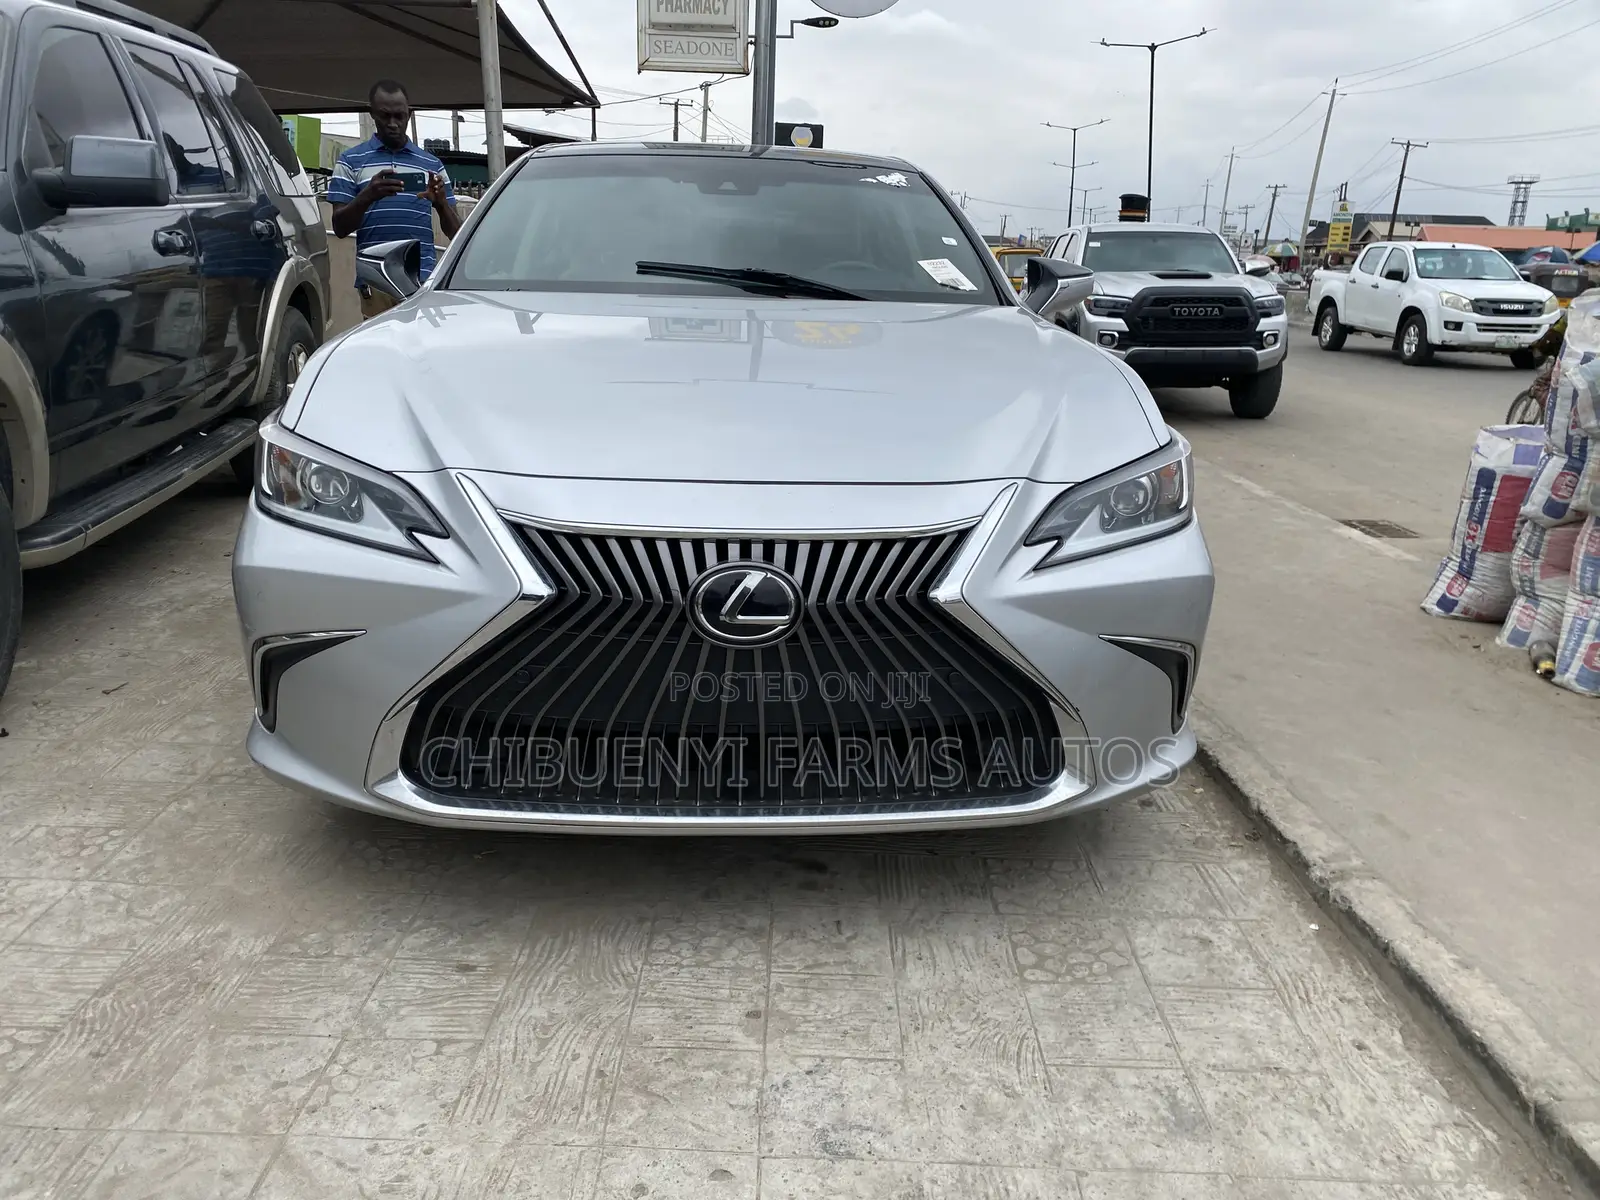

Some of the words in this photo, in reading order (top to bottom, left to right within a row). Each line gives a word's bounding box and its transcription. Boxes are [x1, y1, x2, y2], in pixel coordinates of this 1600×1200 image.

[656, 0, 729, 15] PHARMACY
[653, 40, 735, 57] SEADONE
[1173, 307, 1220, 317] TOYOTA
